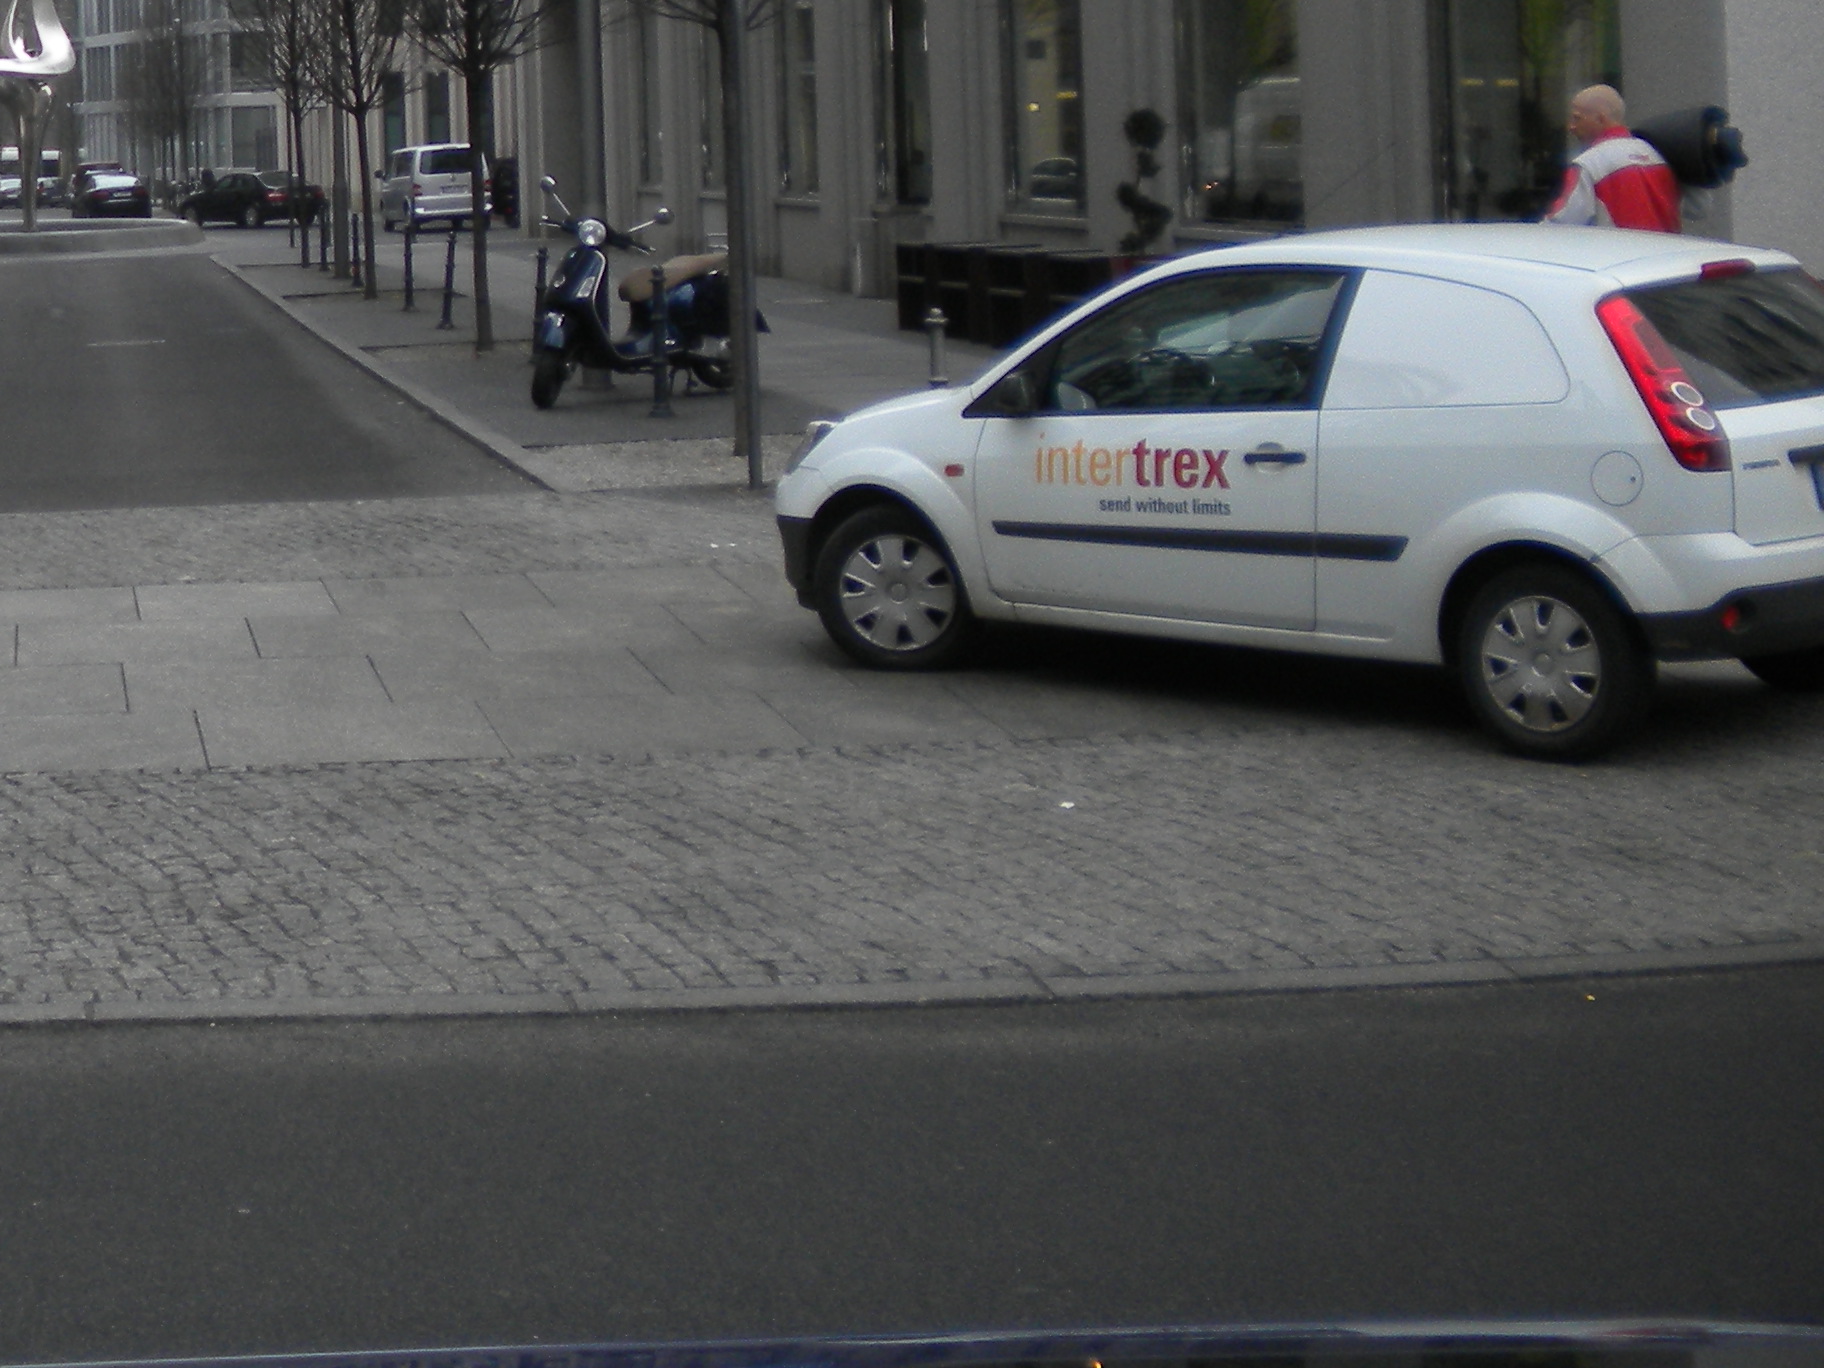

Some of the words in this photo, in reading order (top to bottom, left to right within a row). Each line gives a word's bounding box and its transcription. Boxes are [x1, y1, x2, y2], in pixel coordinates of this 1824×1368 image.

[1036, 432, 1230, 489] intertrex
[1099, 496, 1131, 513] send
[1136, 497, 1189, 514] without
[1193, 499, 1231, 516] limits
